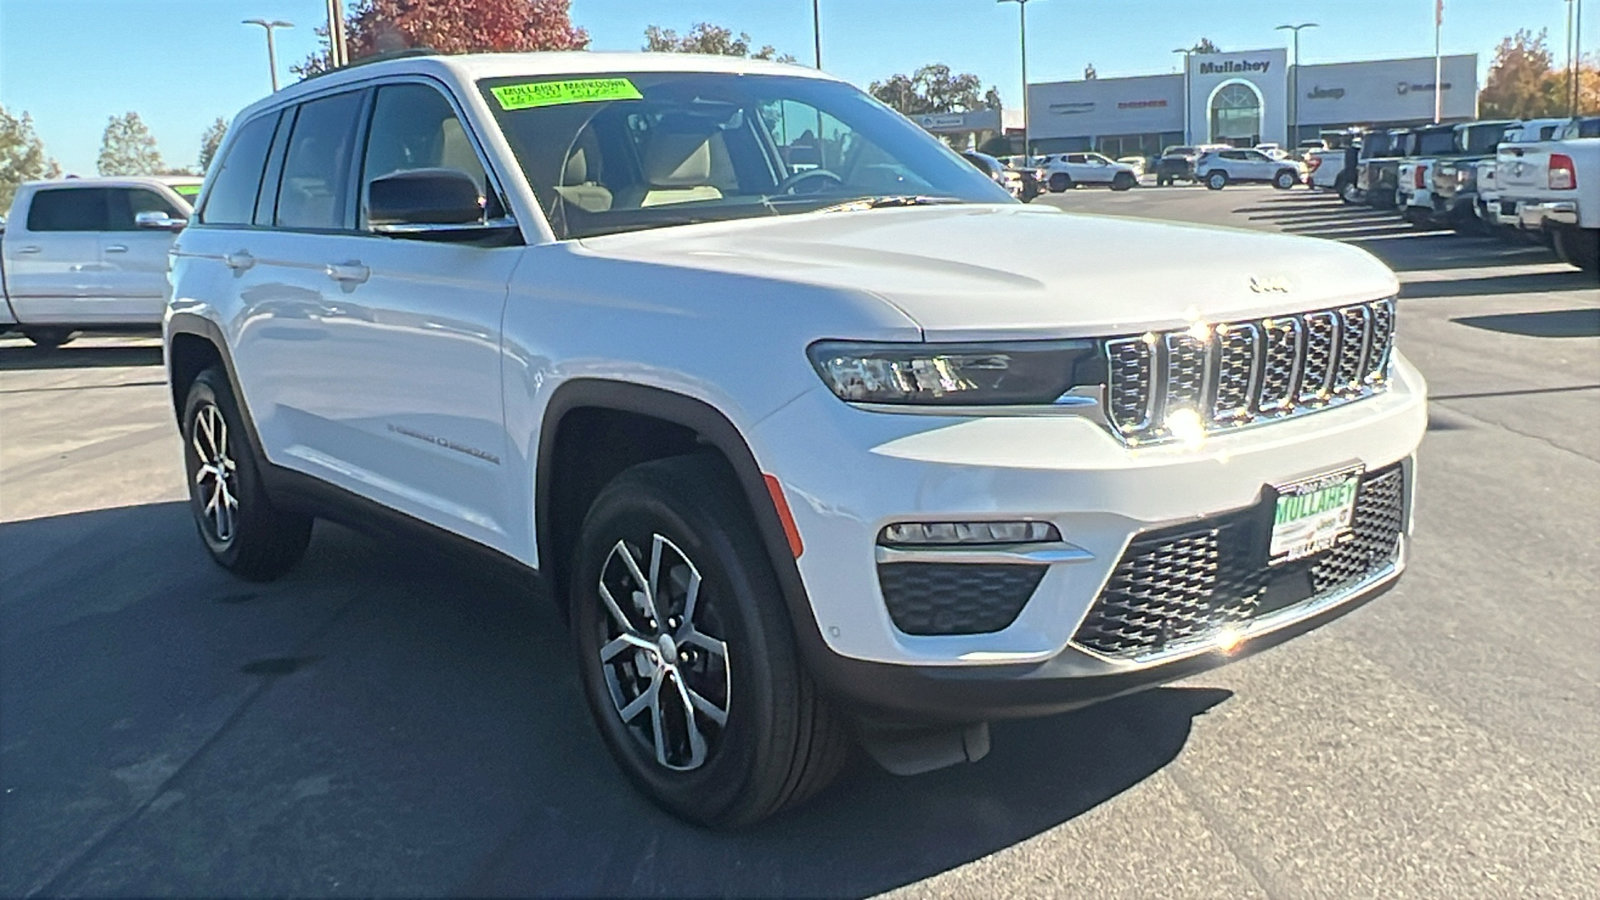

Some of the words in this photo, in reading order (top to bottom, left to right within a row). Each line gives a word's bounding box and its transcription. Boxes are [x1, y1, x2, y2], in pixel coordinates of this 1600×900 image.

[1200, 60, 1270, 74] Mullahey
[502, 84, 561, 96] MULLAHEY
[1275, 482, 1357, 525] MULLAHEY
